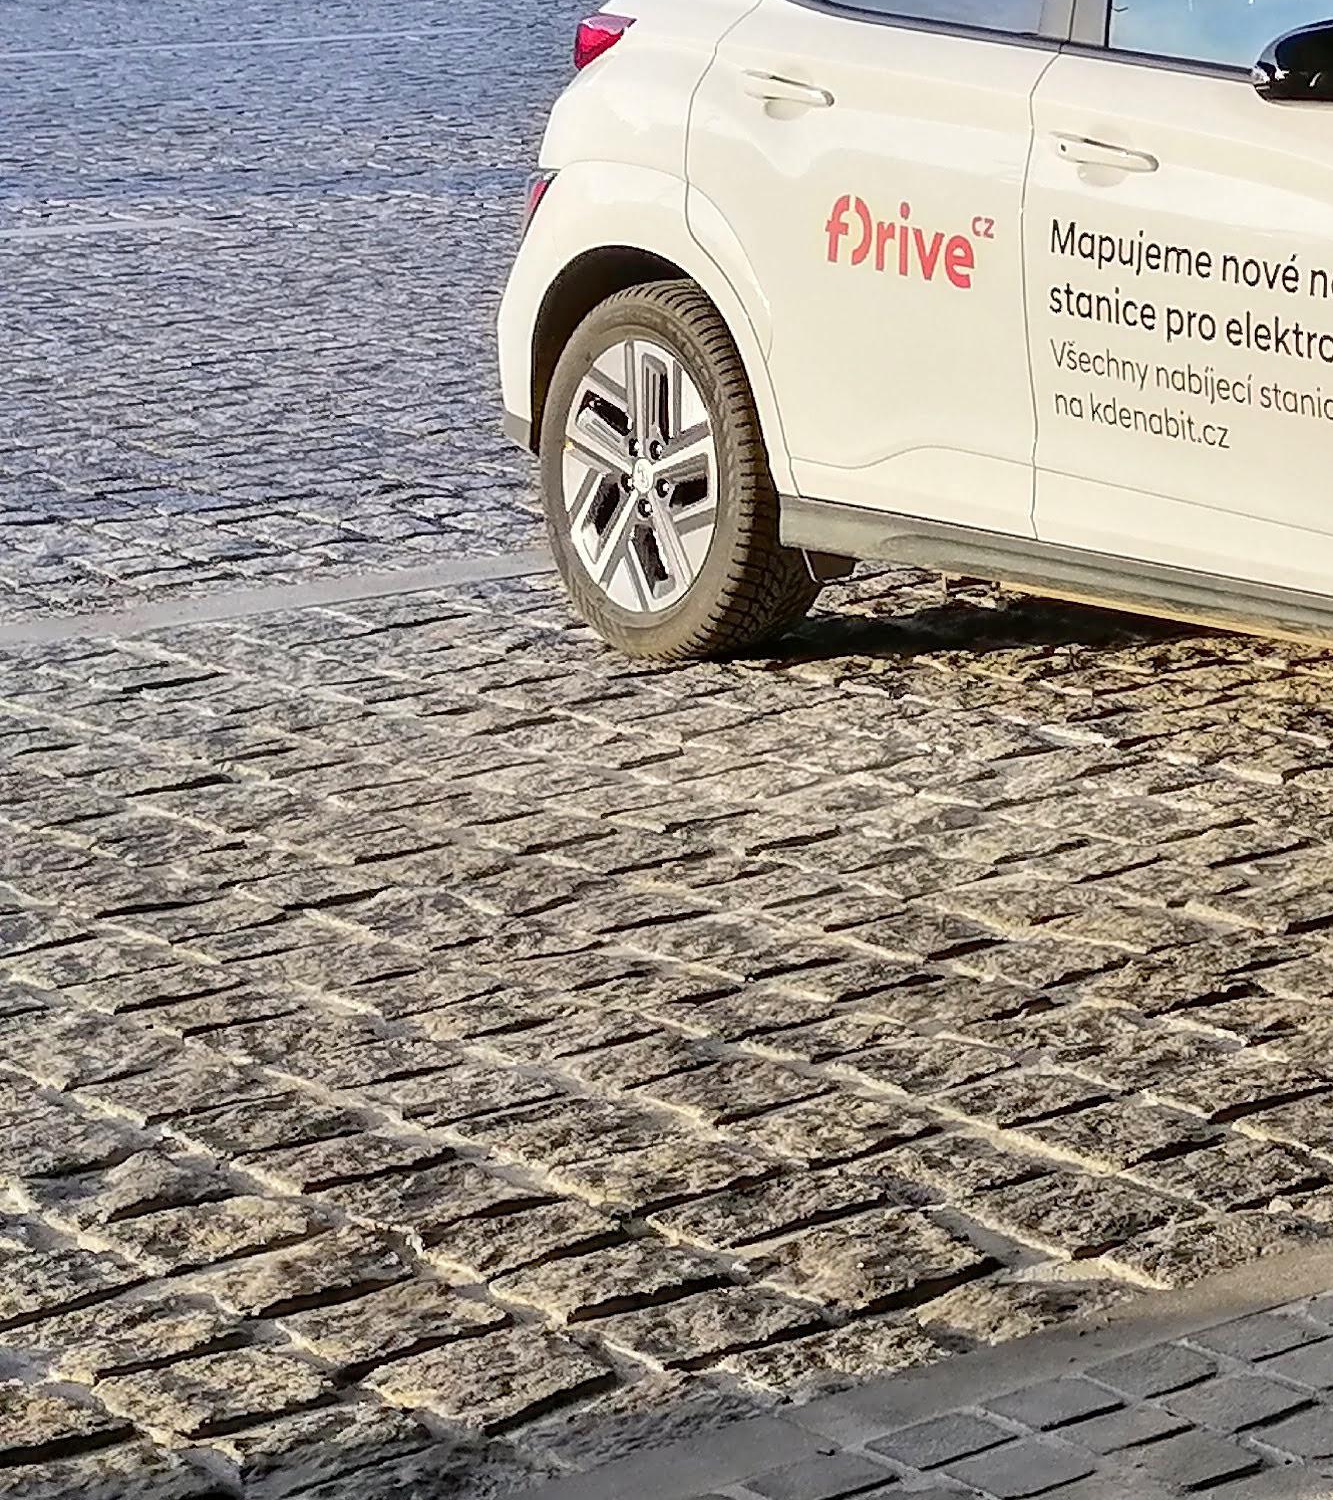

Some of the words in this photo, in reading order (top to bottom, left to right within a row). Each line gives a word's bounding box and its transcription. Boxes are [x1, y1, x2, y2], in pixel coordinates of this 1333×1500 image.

[1050, 219, 1212, 276] Mapujeme
[1222, 253, 1299, 293] nové
[1050, 283, 1156, 330] stanice
[1167, 307, 1216, 342] pro
[1049, 338, 1148, 391] Všechny
[1156, 364, 1252, 404] nabíjecí
[1055, 393, 1083, 419] na
[1090, 392, 1231, 449] kdenabit.cz
